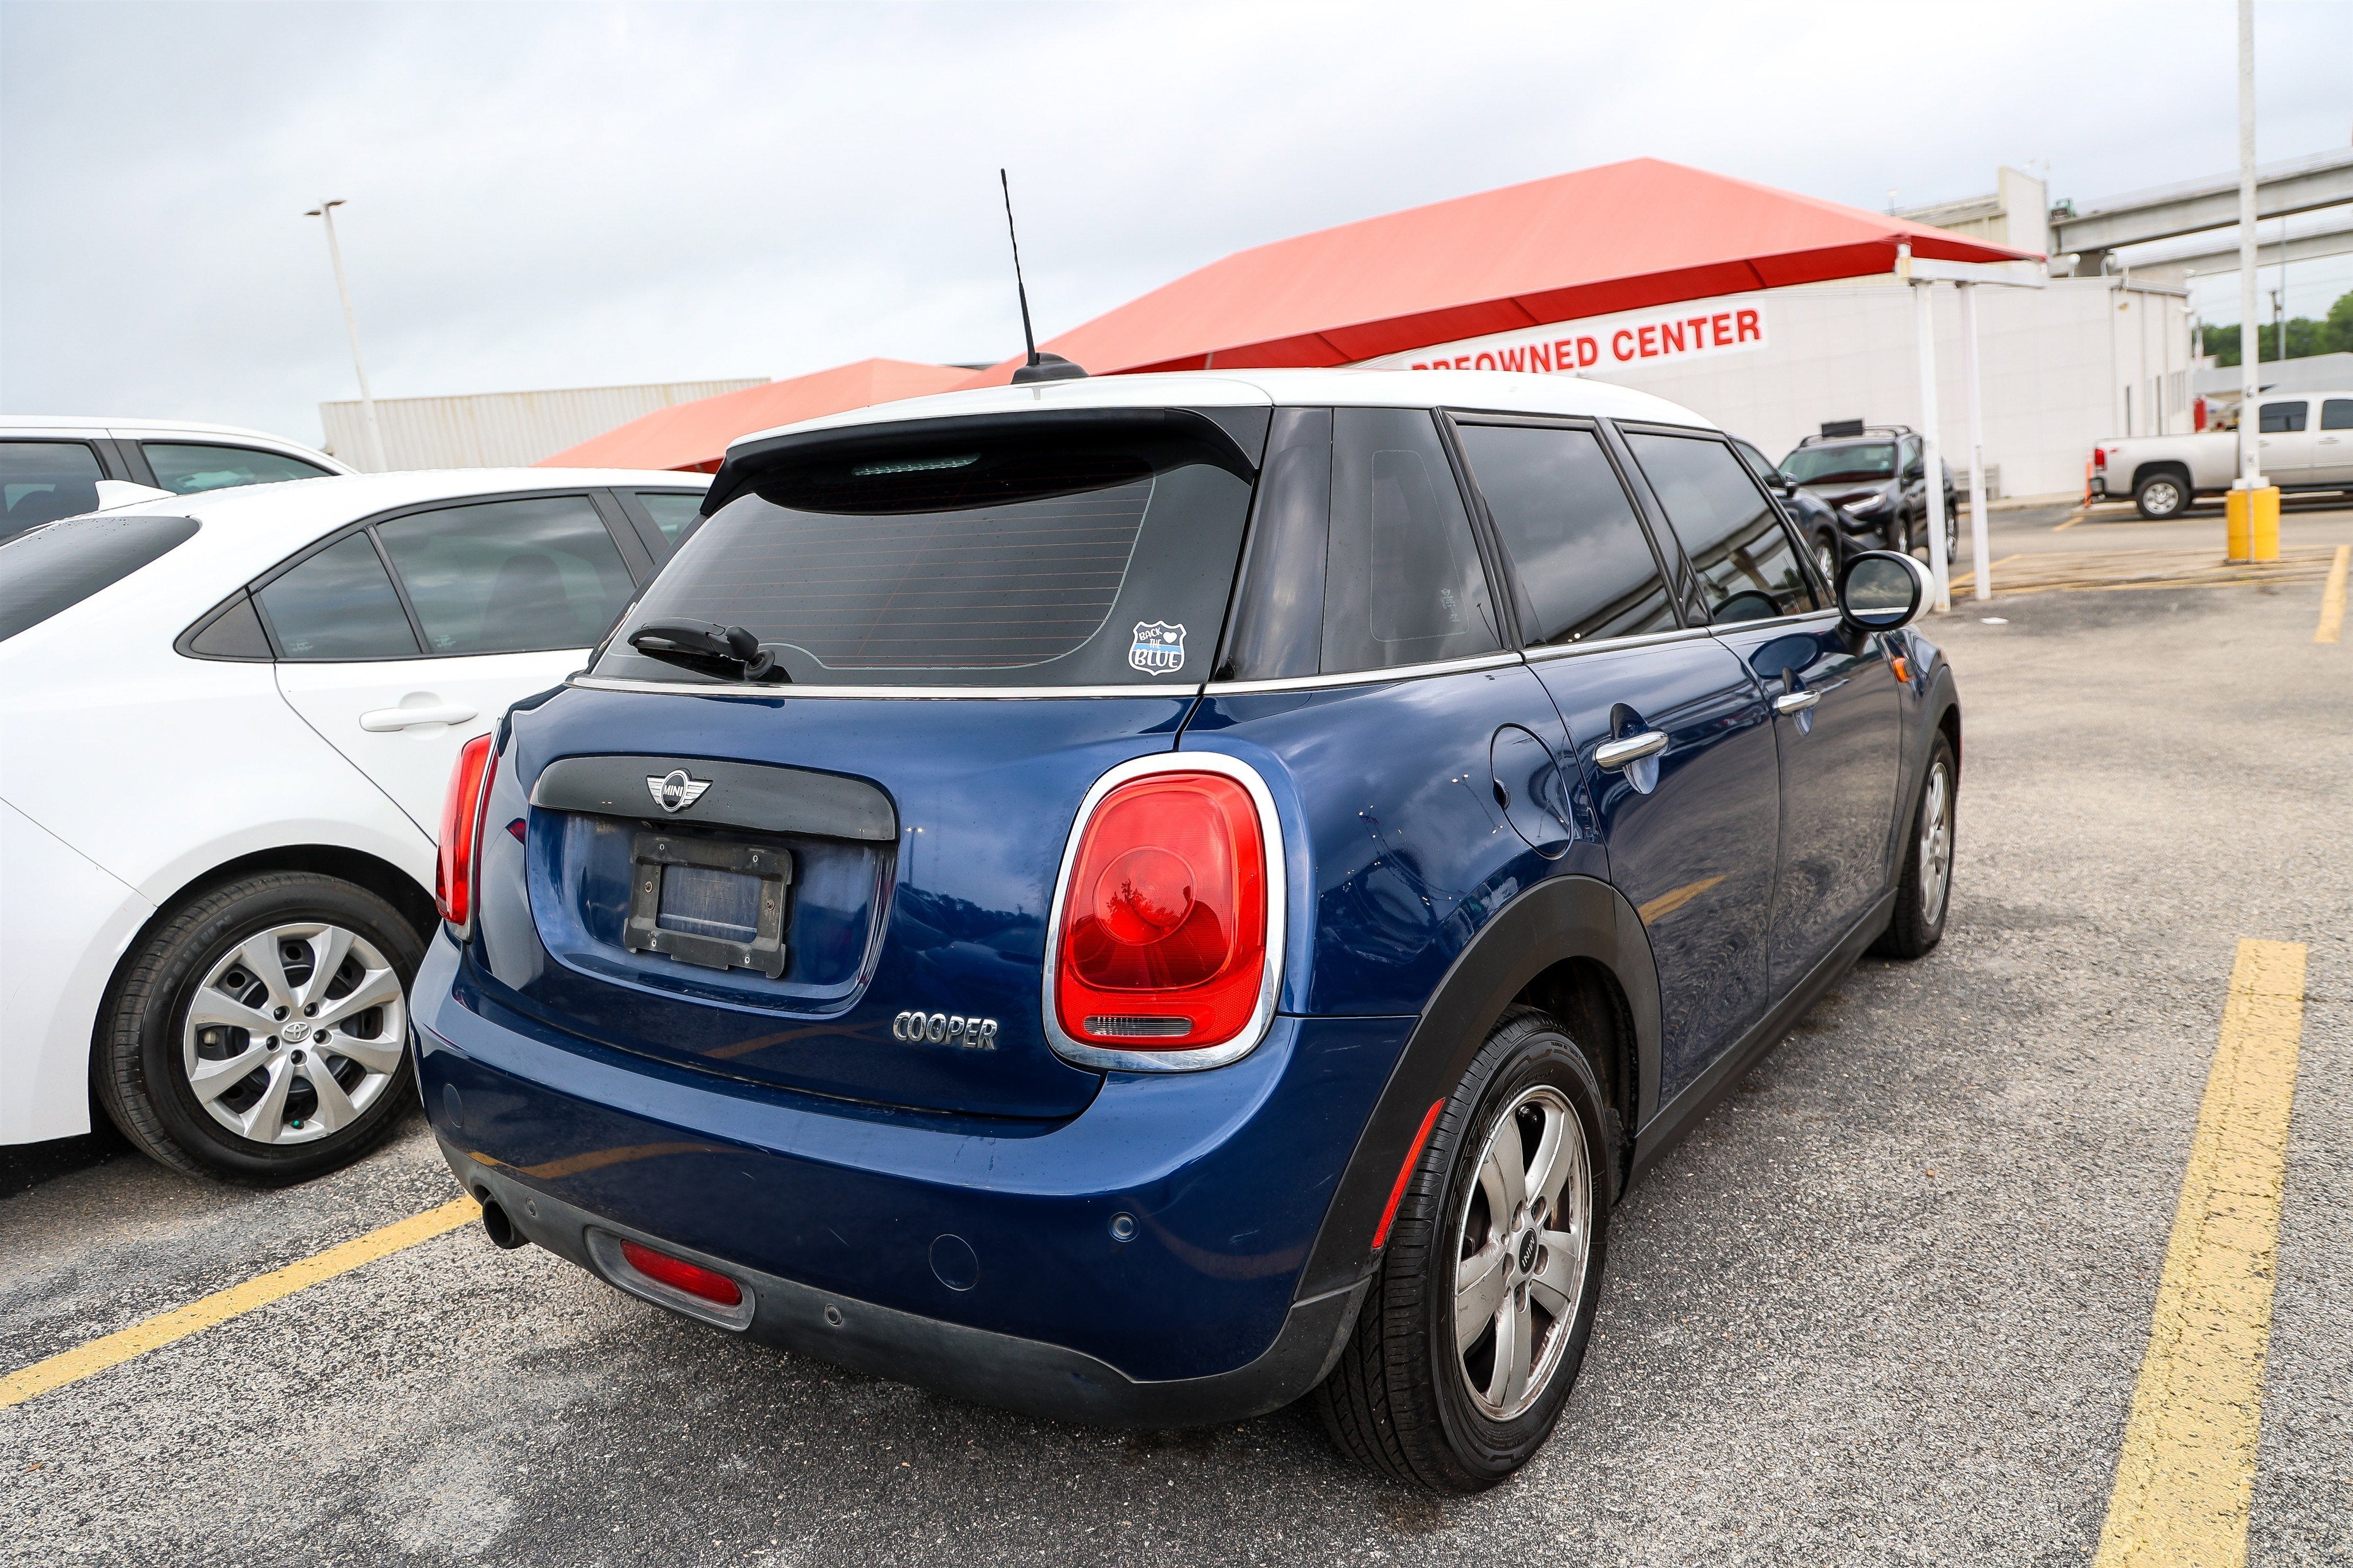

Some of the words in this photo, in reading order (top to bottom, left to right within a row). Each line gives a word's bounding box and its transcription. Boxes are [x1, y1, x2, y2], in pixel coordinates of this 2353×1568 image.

[1411, 337, 1598, 373] OWNED
[1613, 308, 1762, 362] CENTER
[1139, 627, 1163, 640] BACK
[1150, 639, 1162, 649] THE
[1135, 648, 1178, 668] BLUE
[663, 785, 684, 797] MINI
[163, 914, 232, 993] SAILUN
[893, 1011, 998, 1050] COOPER
[1448, 1102, 1492, 1228] TOYO
[1521, 1234, 1536, 1268] MINI
